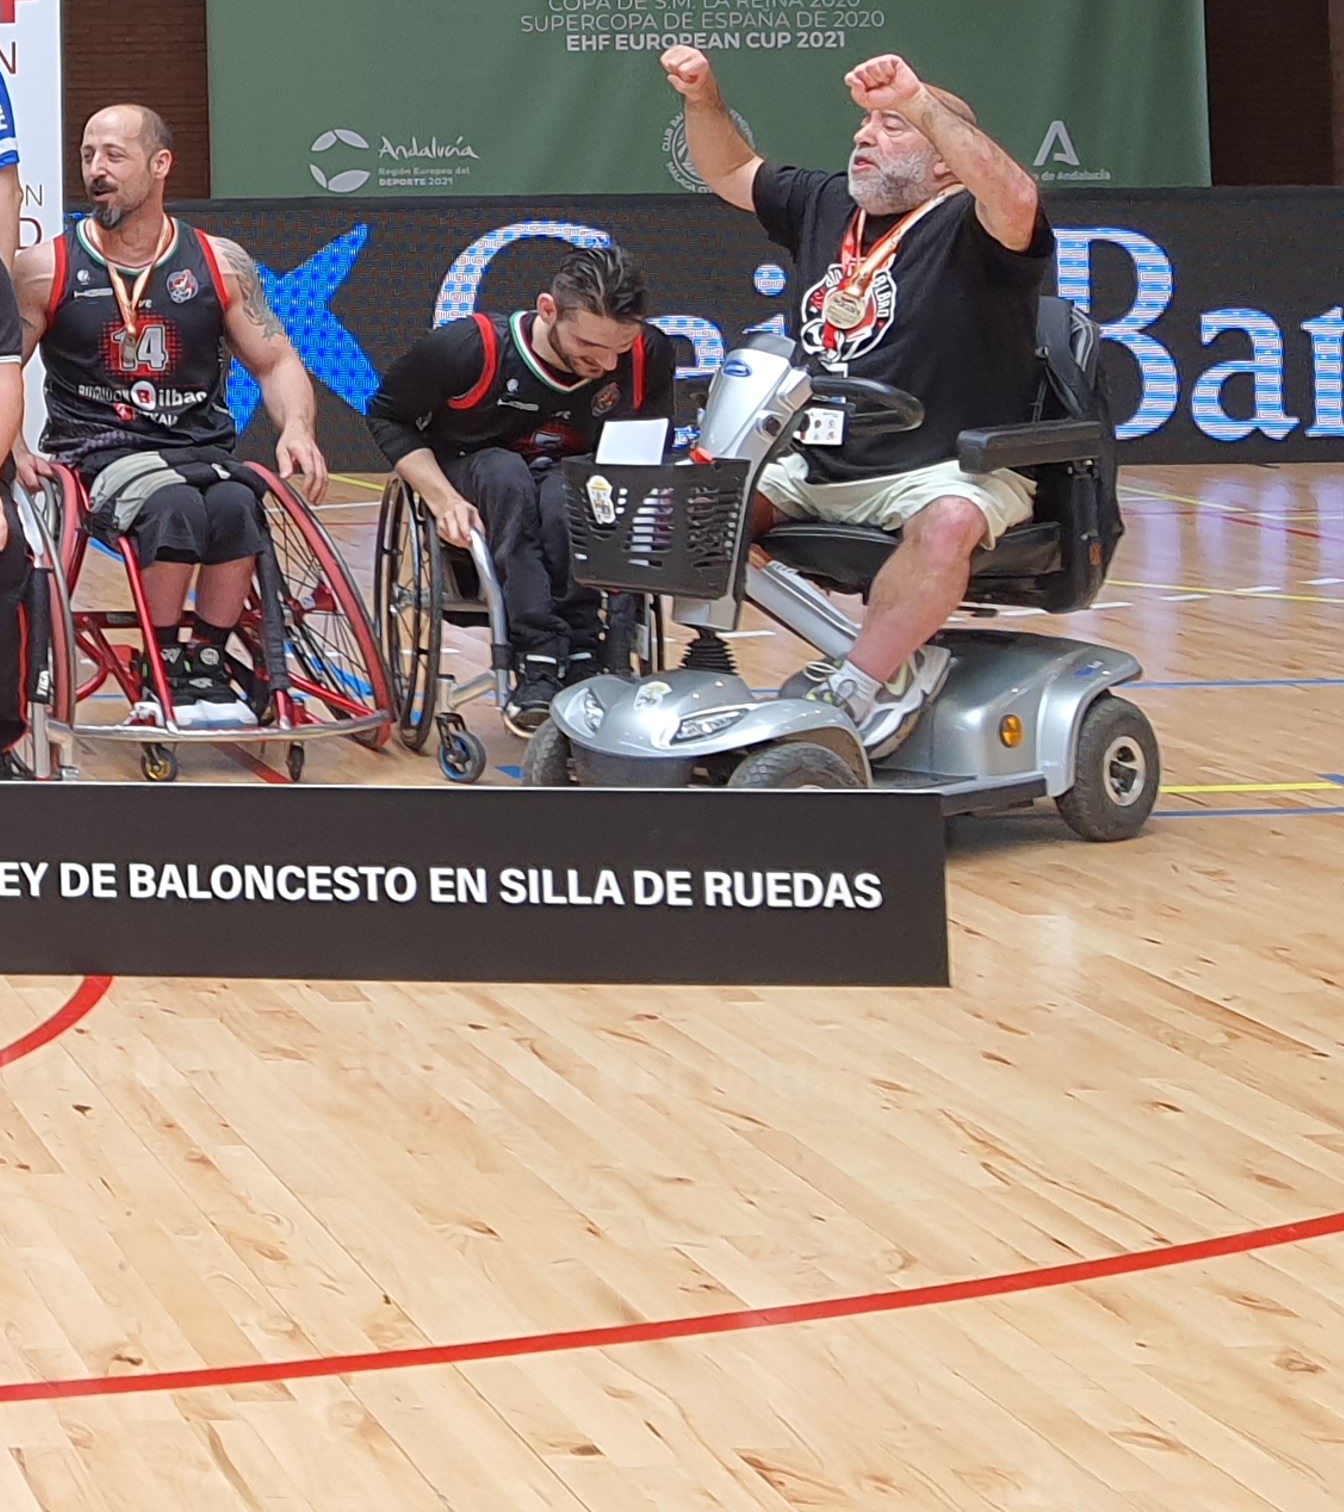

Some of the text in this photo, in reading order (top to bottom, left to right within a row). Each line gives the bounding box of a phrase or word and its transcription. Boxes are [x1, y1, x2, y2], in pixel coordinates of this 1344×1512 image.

[520, 7, 885, 32] SUPERCOPA DE ESPAÑA DE 2020
[567, 31, 845, 51] EHF EUROPEAN CUP 2021
[378, 136, 479, 160] Andalucía
[379, 178, 453, 186] DEPORTE 2021
[61, 861, 117, 900] DE
[130, 863, 418, 904] BALONCESTO
[431, 867, 488, 906] EN
[498, 867, 624, 907] SILLA
[637, 870, 693, 908] DE
[704, 871, 884, 910] RUEDAS
